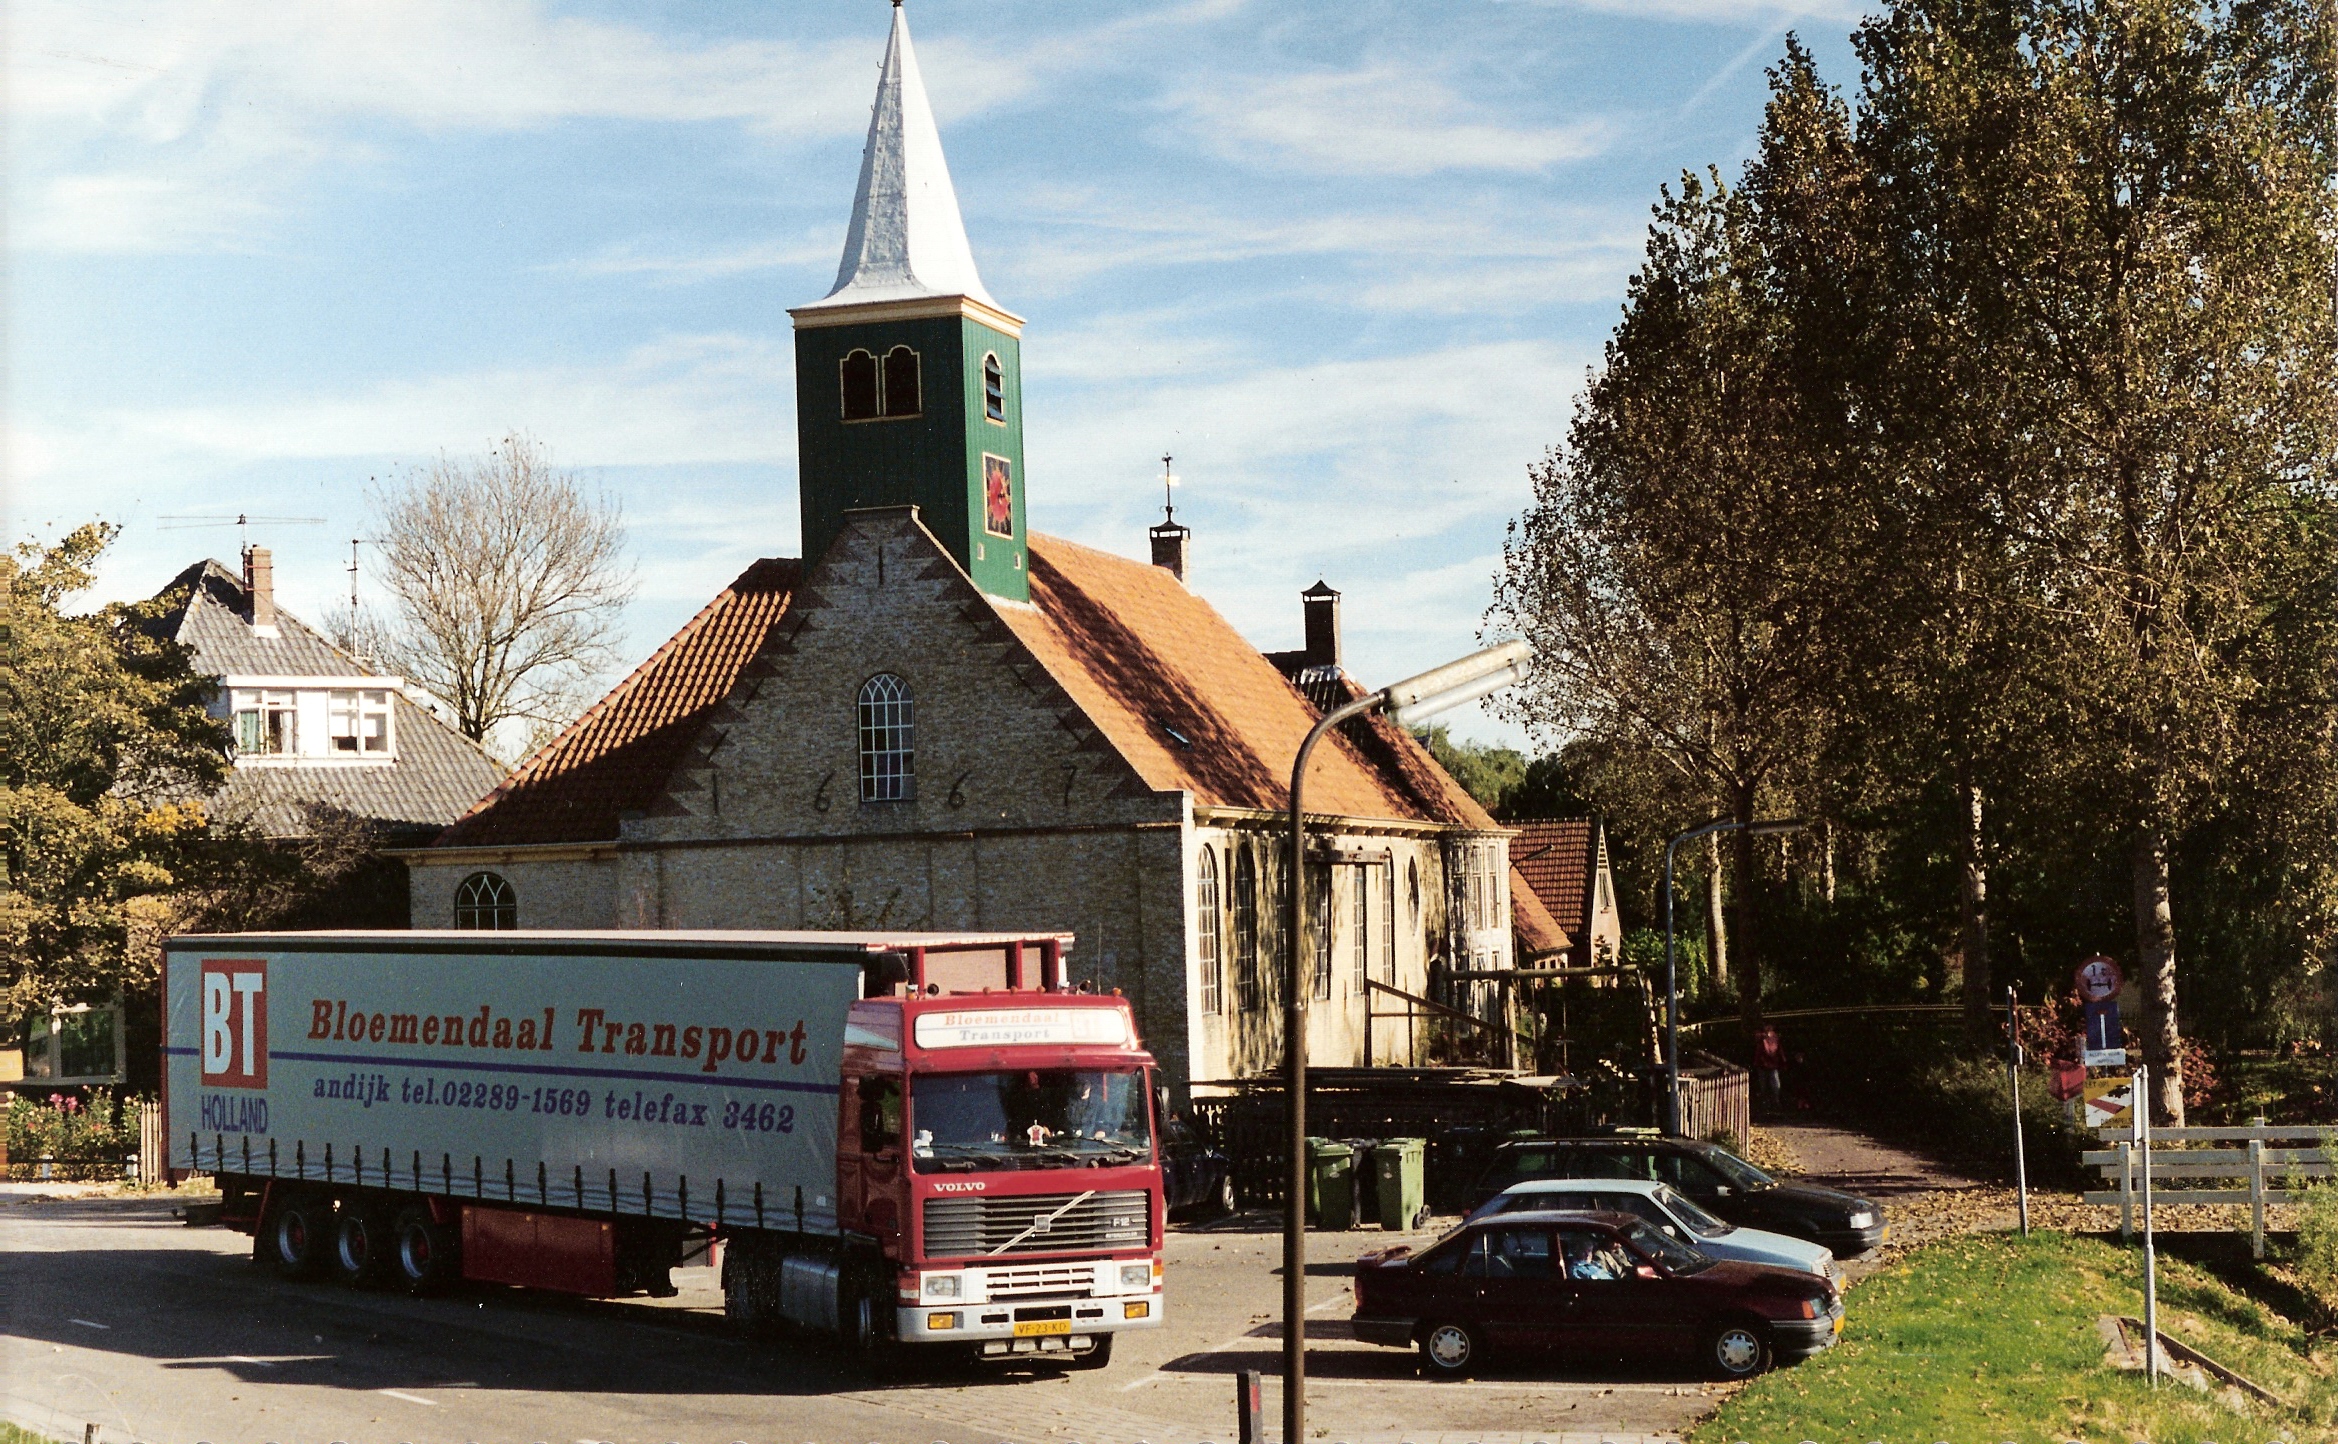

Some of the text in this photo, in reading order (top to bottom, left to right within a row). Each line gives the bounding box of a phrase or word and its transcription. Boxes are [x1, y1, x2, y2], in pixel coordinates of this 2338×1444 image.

[204, 972, 263, 1076] BT
[944, 1012, 1060, 1026] Bloemendaal
[307, 999, 807, 1072] Bloemendaal Transport
[959, 1028, 1050, 1042] Transport
[201, 1094, 268, 1134] HOLLAND
[313, 1073, 794, 1134] andijk tel.02289-1569 telefax 3462
[933, 1182, 986, 1192] VOLVO
[1018, 1322, 1067, 1334] VF-23-KD
